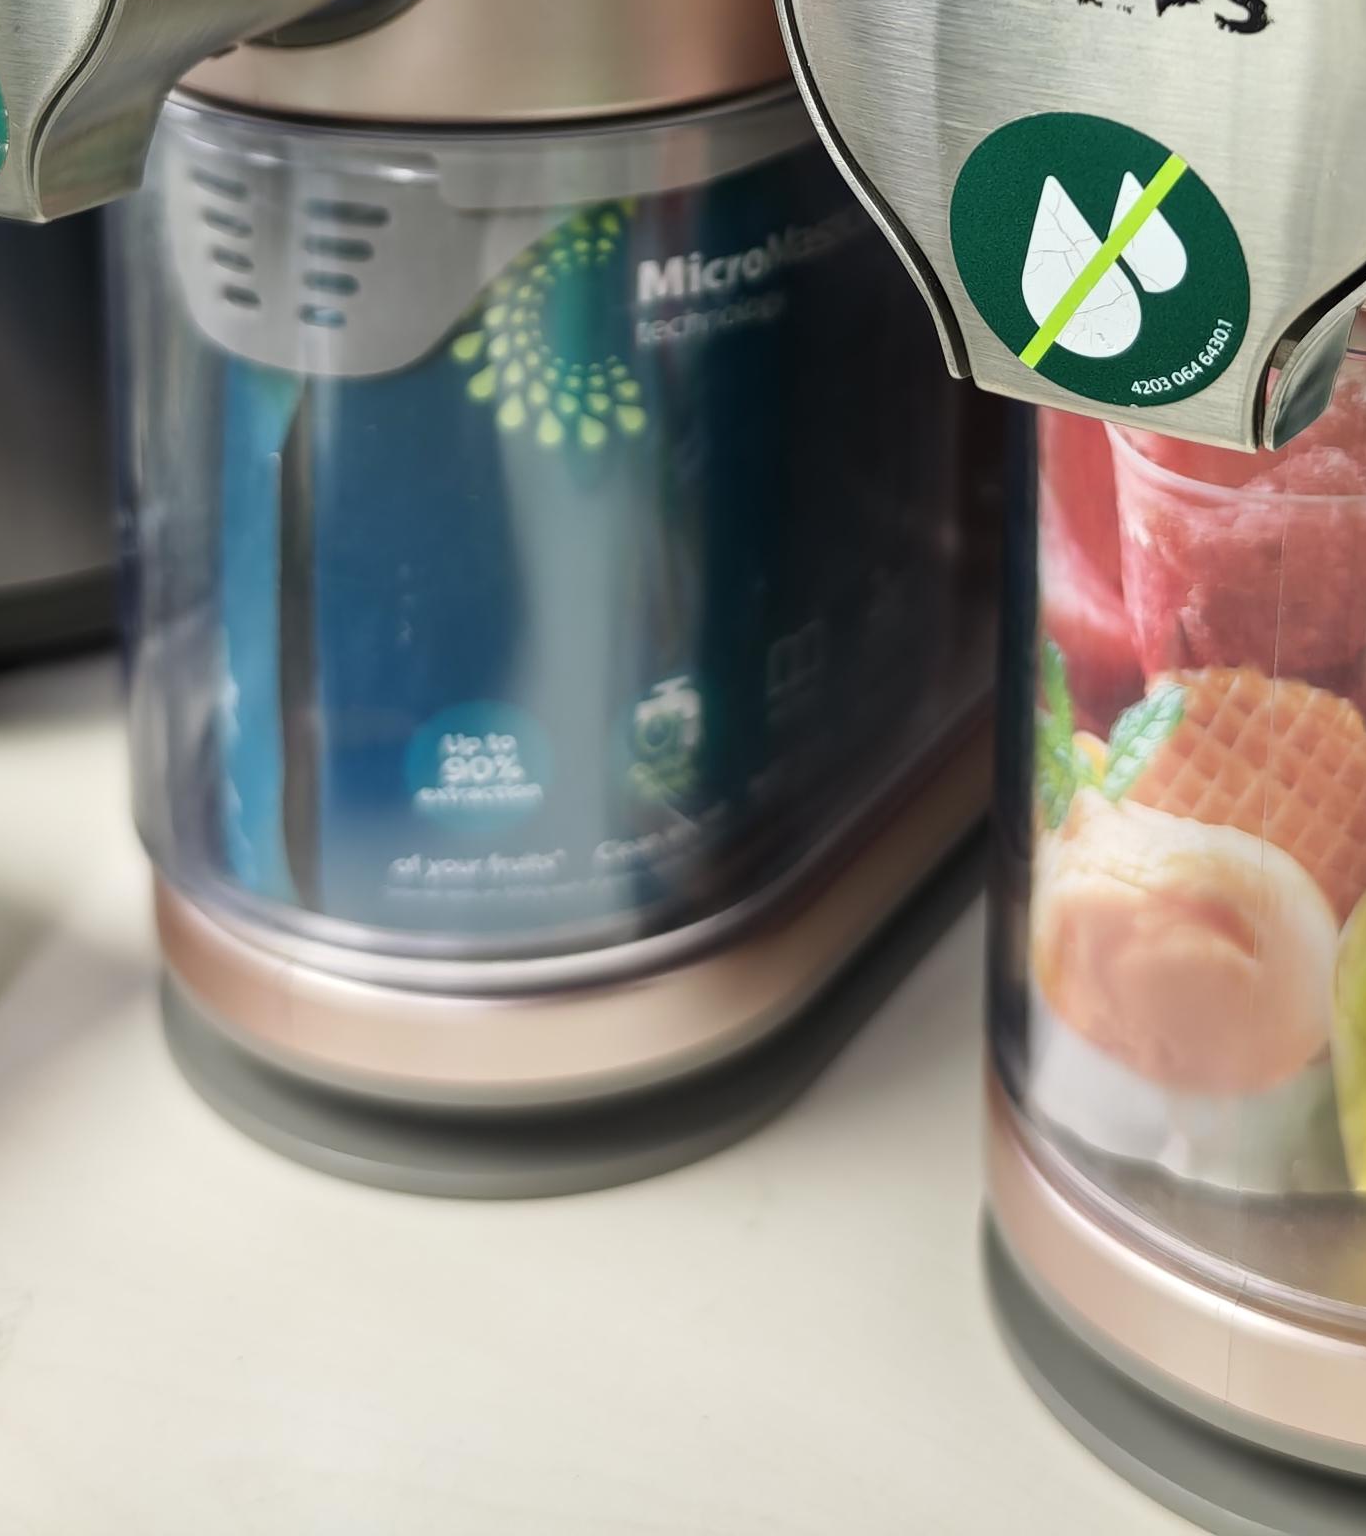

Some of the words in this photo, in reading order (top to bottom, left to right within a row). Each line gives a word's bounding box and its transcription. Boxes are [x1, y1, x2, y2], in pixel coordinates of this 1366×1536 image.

[1131, 376, 1172, 395] 4203
[1171, 361, 1204, 386] 064
[442, 732, 483, 756] Up
[485, 732, 517, 754] to
[441, 754, 525, 783] 90%
[425, 857, 483, 878] your
